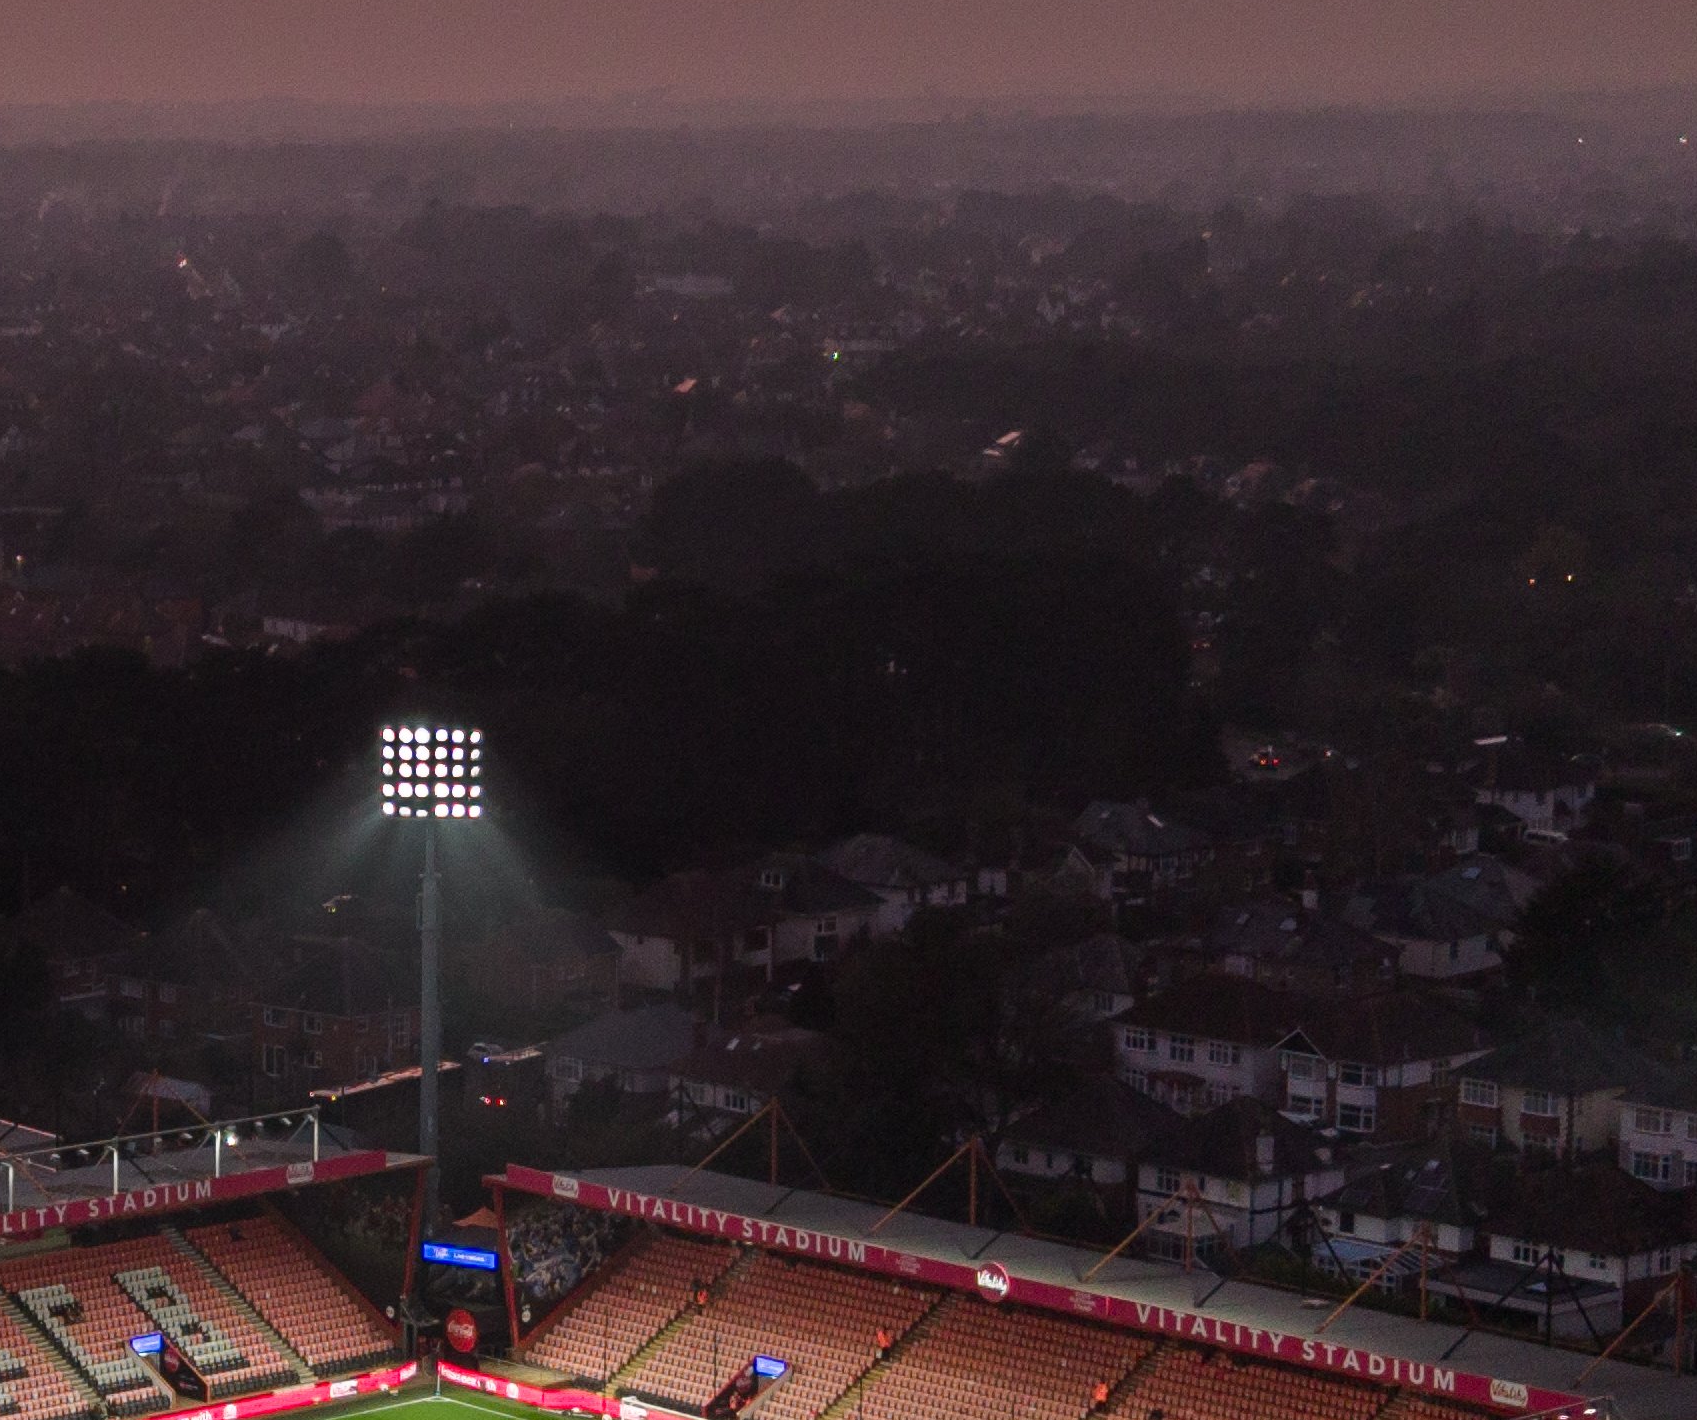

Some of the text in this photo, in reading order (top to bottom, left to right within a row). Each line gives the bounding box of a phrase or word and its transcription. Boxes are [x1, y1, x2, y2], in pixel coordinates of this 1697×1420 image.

[88, 1180, 212, 1218] STADIUM
[607, 1188, 866, 1263] VITALITY STADIUM
[1135, 1303, 1455, 1391] VITALITY STADIUM
